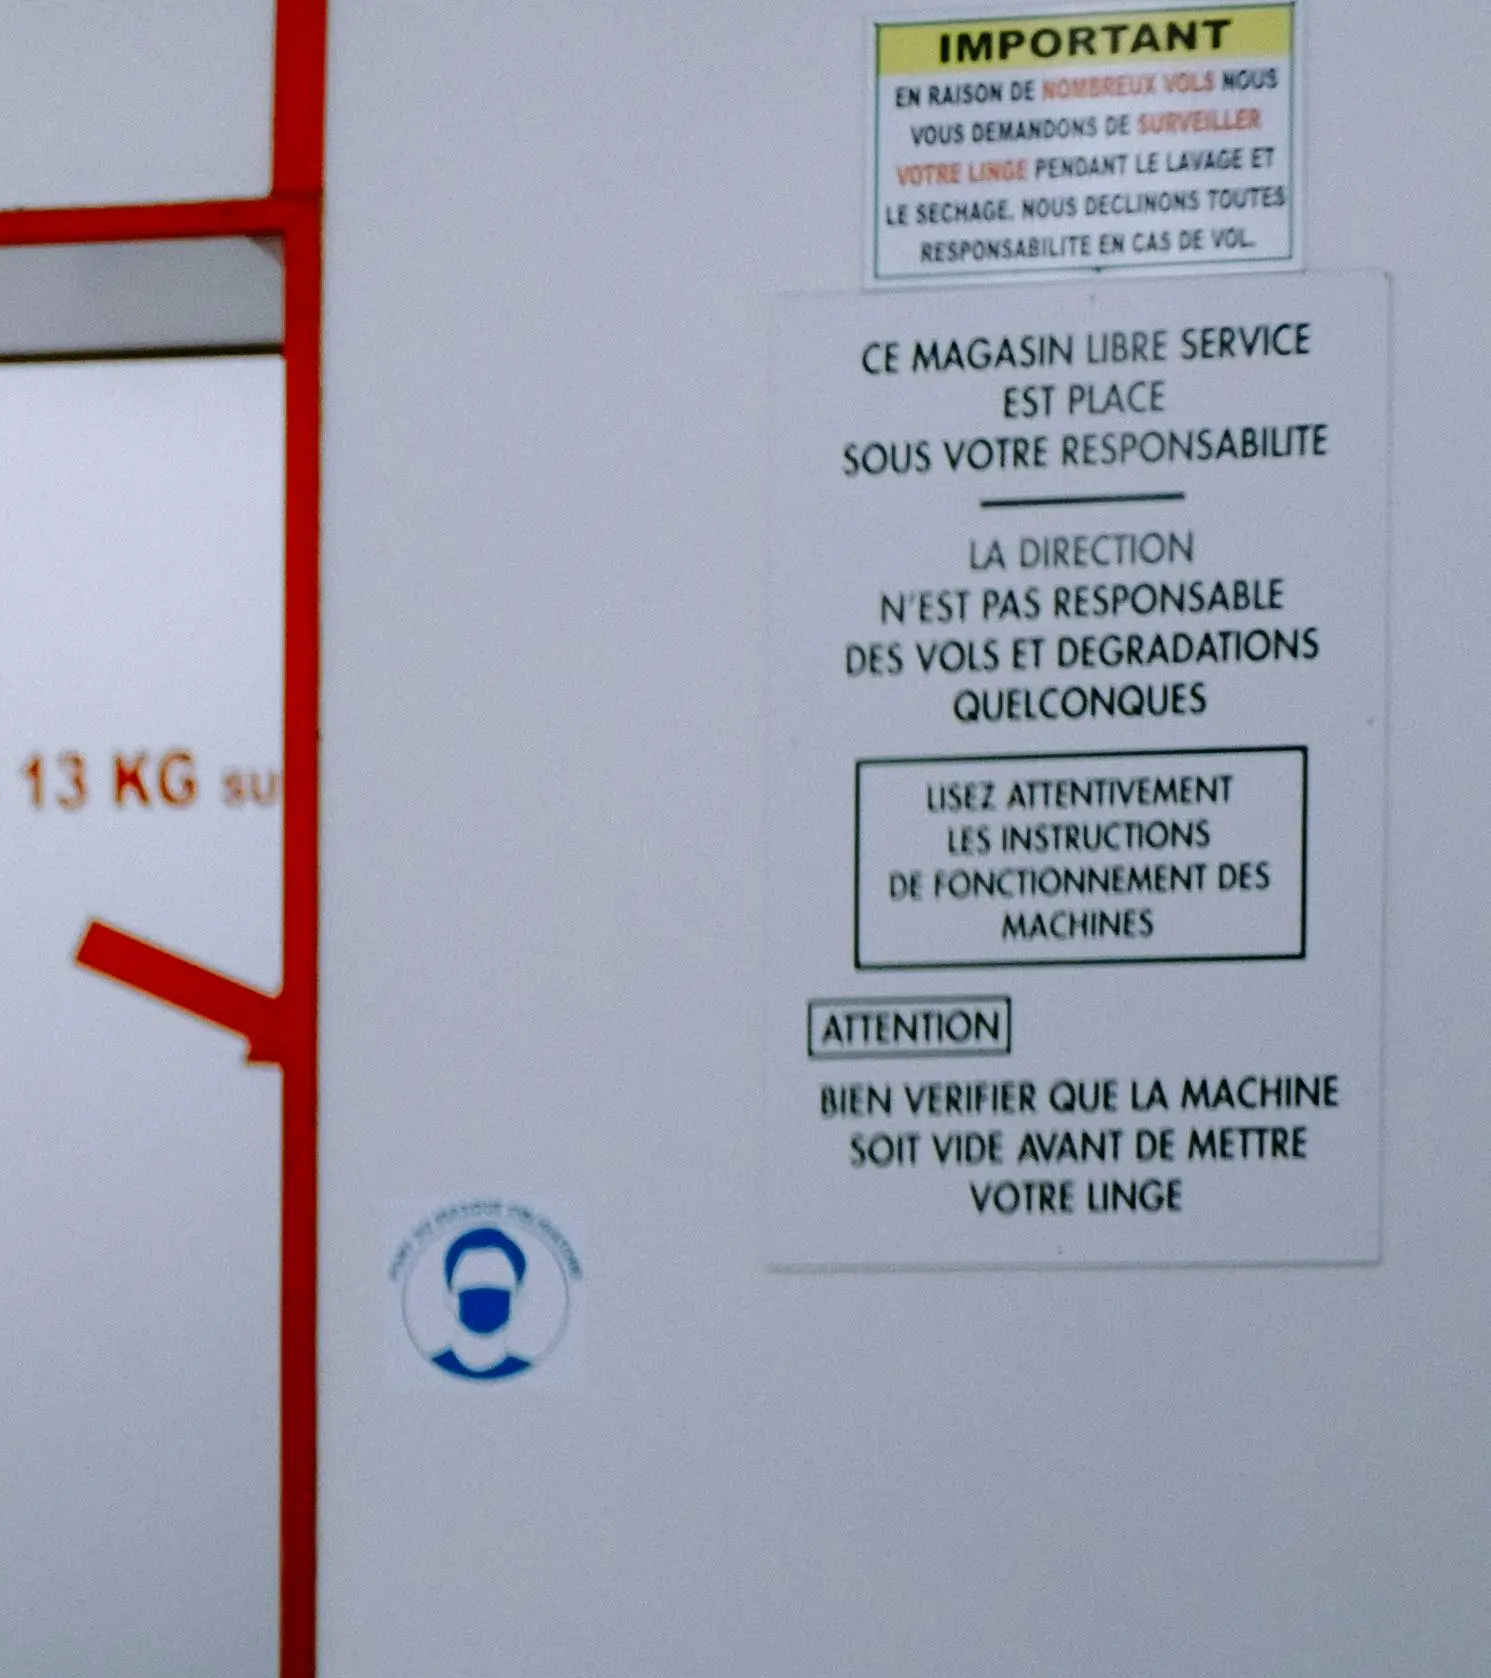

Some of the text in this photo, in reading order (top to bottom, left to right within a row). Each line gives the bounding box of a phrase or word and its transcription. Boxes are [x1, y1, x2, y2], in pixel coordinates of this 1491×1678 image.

[940, 19, 1231, 63] IMPORTANT
[896, 68, 1278, 107] EN RAISON DE NOMBREUX VOLS NOUS
[911, 108, 1261, 146] VOUS DEMANDONS DE SURVEILLER
[896, 147, 1274, 186] VOTRE LINGE PENDANT LE LAVAGE ET
[886, 204, 906, 226] LE
[1022, 197, 1077, 218] NOUS
[1085, 190, 1199, 216] DECLINONS
[1208, 186, 1286, 209] TOUTES
[921, 235, 1090, 262] RESPONSABILITE
[1099, 234, 1124, 254] EN
[1133, 231, 1171, 253] CAS
[1179, 229, 1203, 250] DE
[862, 323, 1309, 375] CE MAGASIN LIBRE SERVICE
[1004, 380, 1164, 418] EST PLACE
[844, 424, 1327, 475] SOUS VOTRE RESPONSABILITE
[970, 531, 1193, 570] LA DIRECTION
[881, 578, 1282, 623] N'EST PAS RESPONSABLE
[846, 627, 1319, 675] DES VOLS ET DEGRADATIONS
[954, 682, 1206, 722] QUELCONQUES
[22, 751, 88, 811] 13
[114, 752, 196, 806] KG
[928, 775, 1232, 811] LISEZ ATTENTIVEMENT
[949, 819, 1210, 854] LES INSTRUCTIONS
[890, 861, 1270, 899] DE FONCTIONNEMENT DES
[1002, 909, 1153, 938] MACHINES
[823, 1010, 999, 1042] ATTENTION
[821, 1075, 1337, 1115] BIEN VERIFIER QUE LA MACHINE
[851, 1126, 1306, 1166] SOIT VIDE AVANT DE METTRE
[971, 1179, 1180, 1213] VOTRE LINGE
